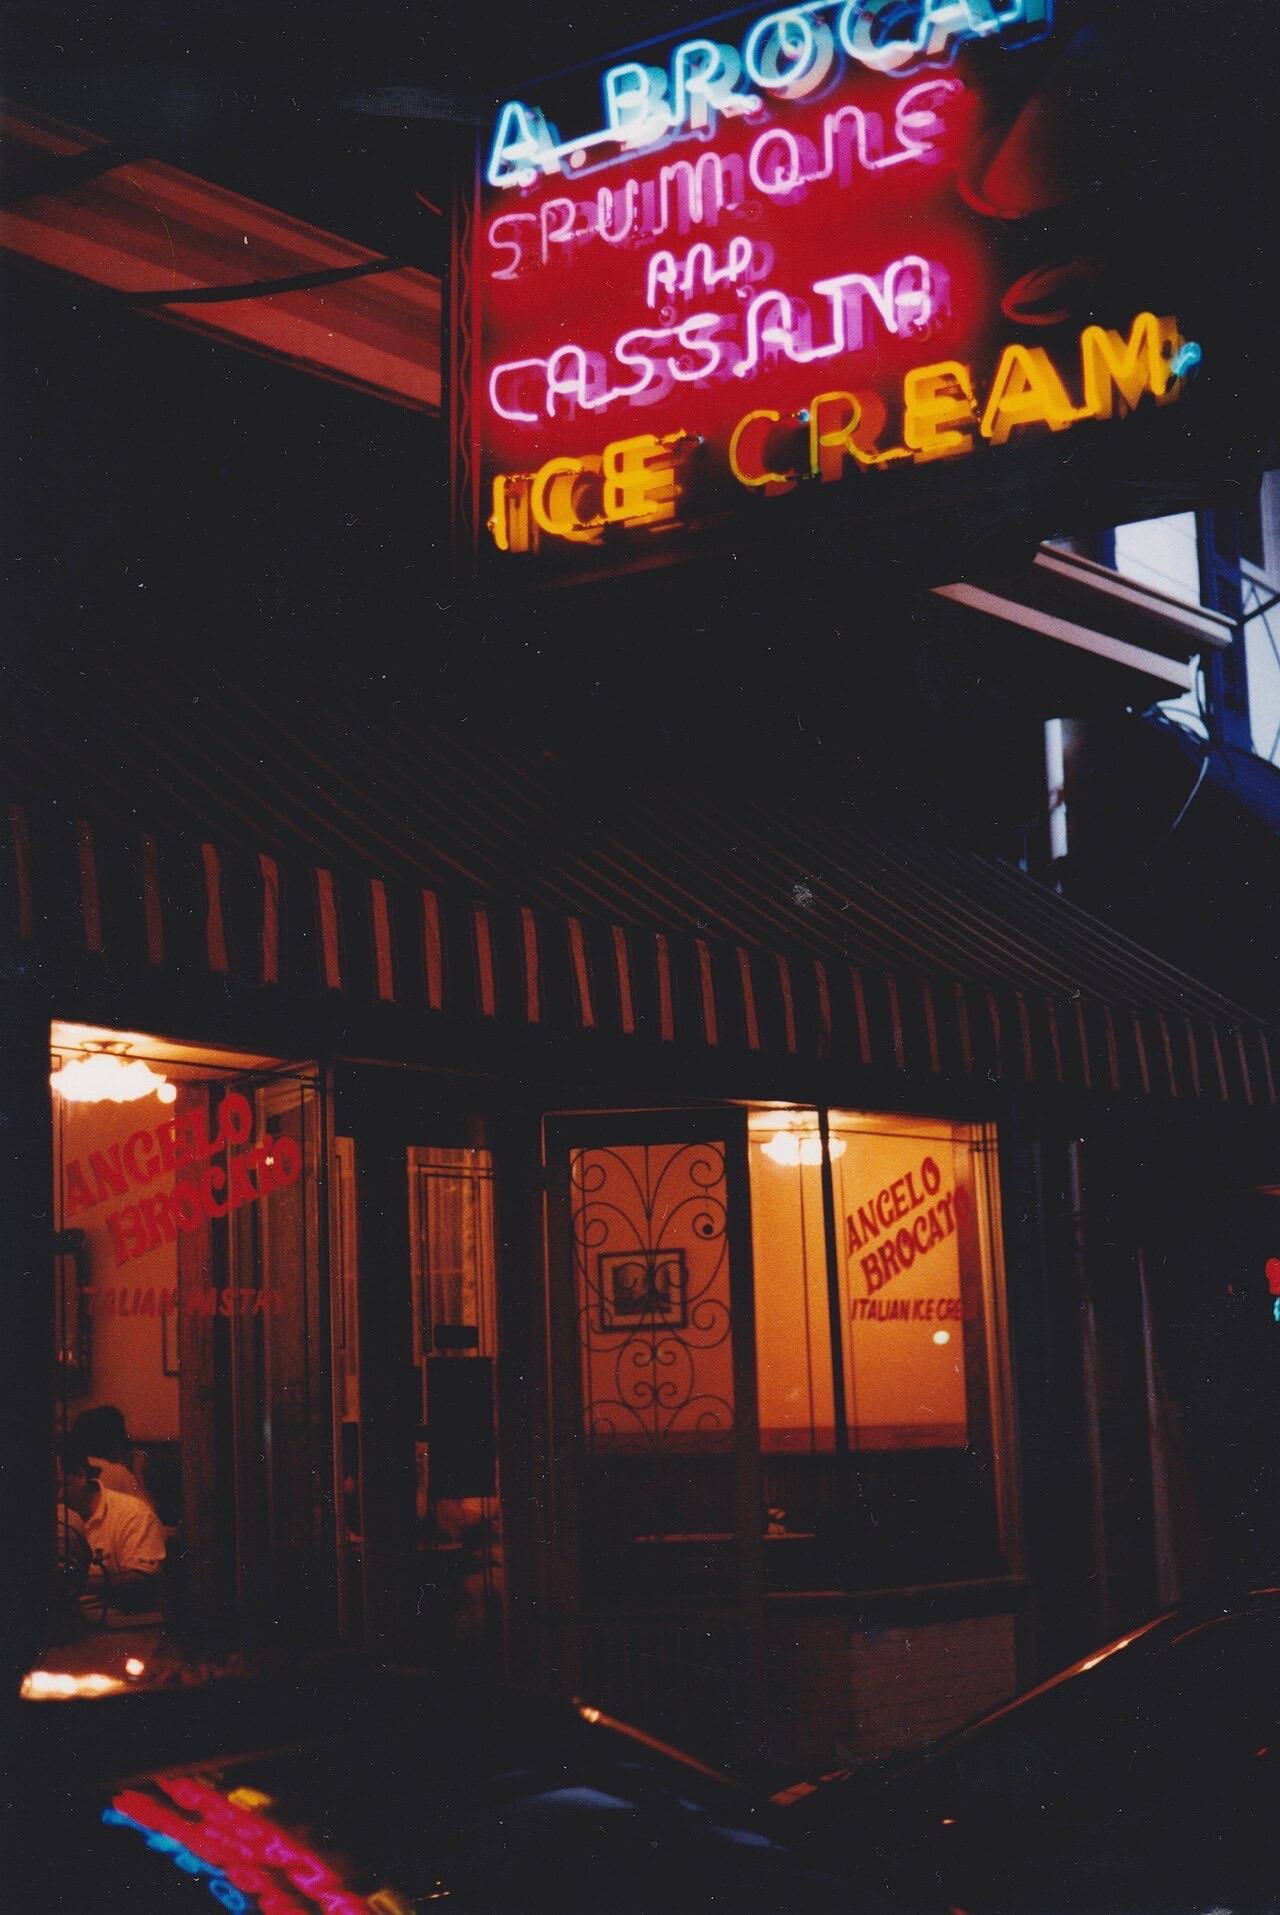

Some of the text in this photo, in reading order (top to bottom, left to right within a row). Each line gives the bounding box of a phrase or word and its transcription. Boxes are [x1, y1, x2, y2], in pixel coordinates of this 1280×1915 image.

[488, 78, 962, 280] SPUMONE
[647, 236, 775, 310] AND
[488, 255, 950, 422] CASSATA
[488, 312, 1182, 552] ICE CREAM
[64, 1092, 253, 1218] ANGELO
[105, 1135, 300, 1268] BROCATO
[846, 1156, 941, 1257] ANGELO
[77, 1286, 178, 1316] TALIAN
[850, 1297, 910, 1322] ITALIAN
